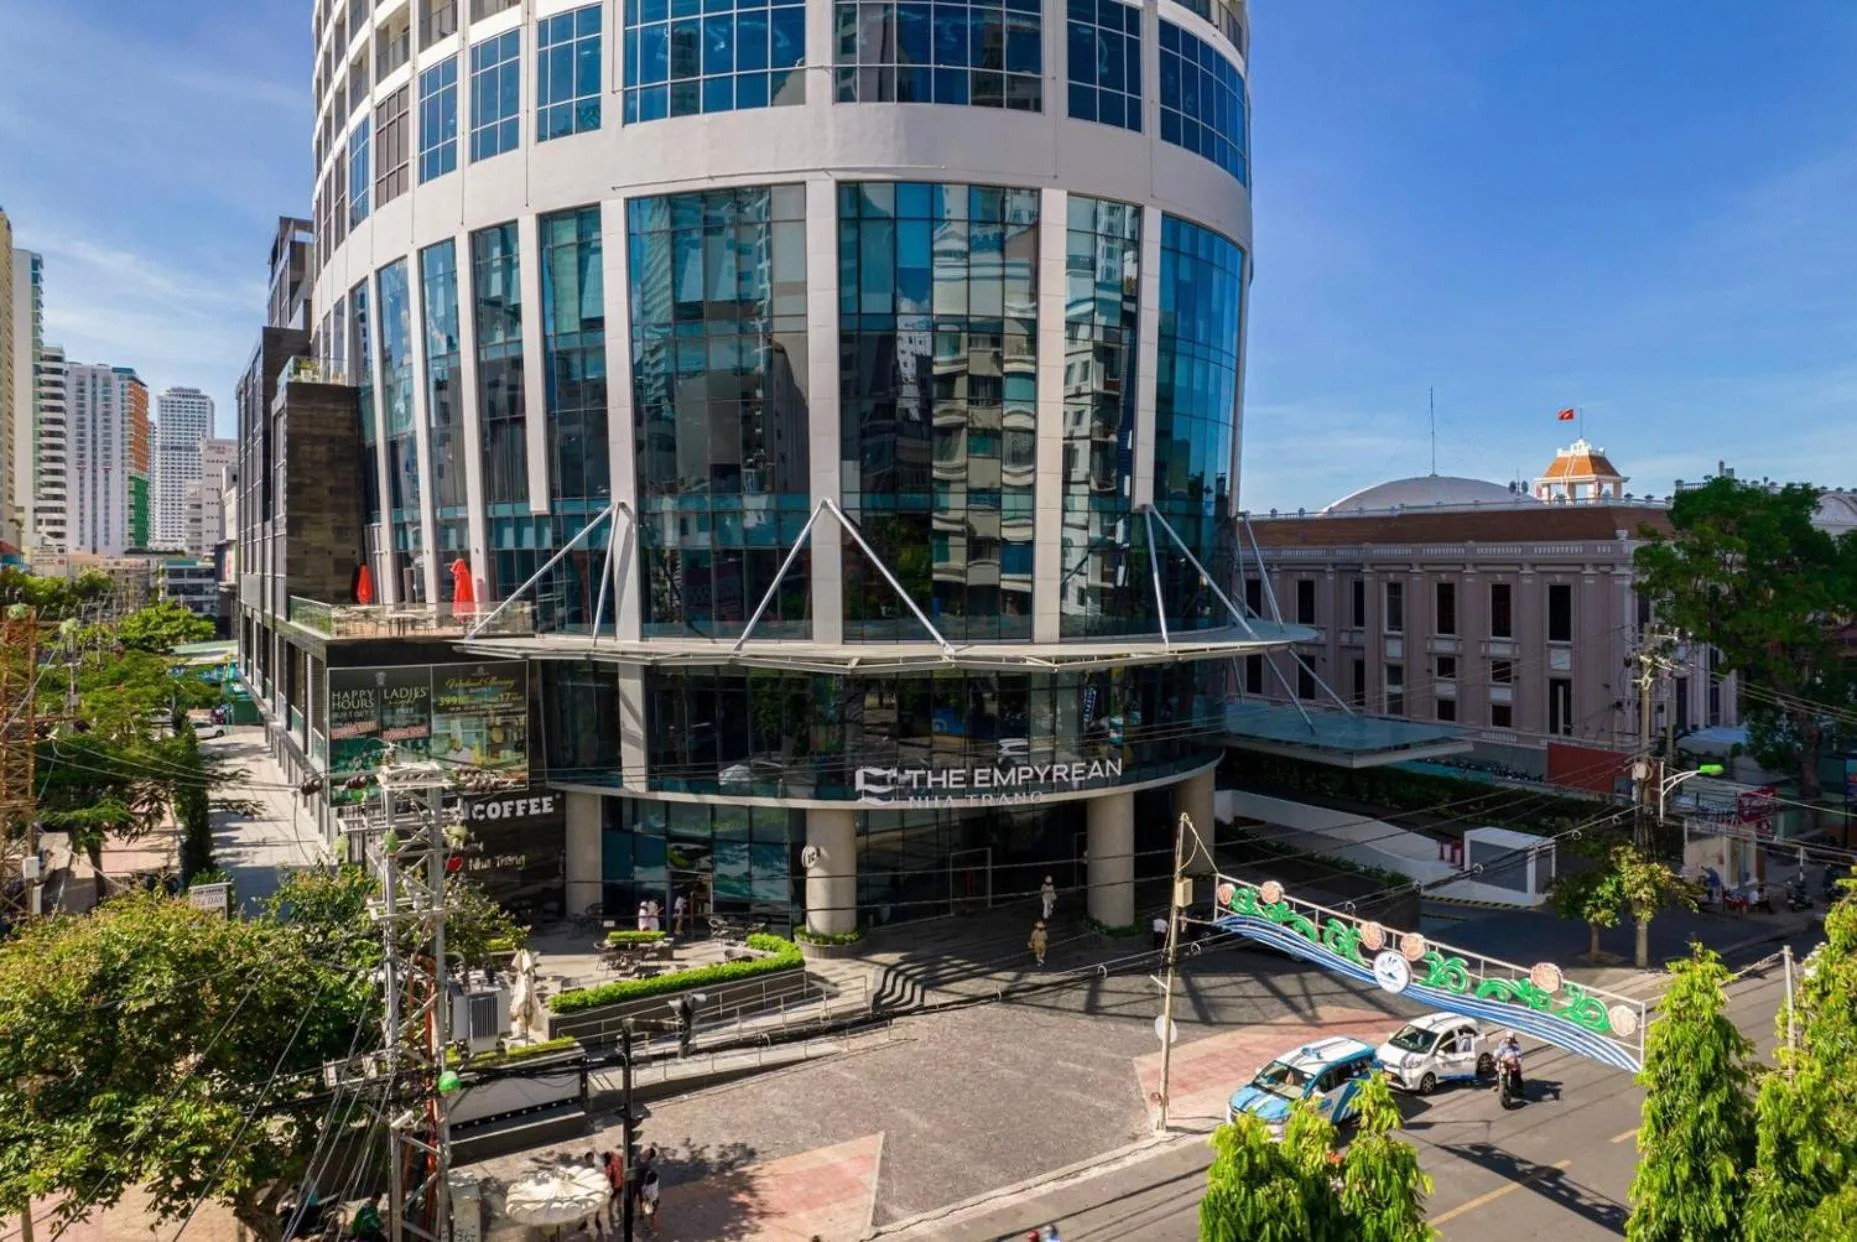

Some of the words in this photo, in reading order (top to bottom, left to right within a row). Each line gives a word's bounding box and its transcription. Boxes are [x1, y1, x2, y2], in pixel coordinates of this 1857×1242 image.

[332, 688, 374, 700] HAPPY
[332, 698, 374, 710] HOURS
[904, 769, 967, 789] THE
[973, 757, 1123, 788] EMPYREAN
[908, 794, 954, 808] NHA
[964, 790, 1043, 807] TRANG
[471, 796, 554, 821] COFFEE
[468, 858, 492, 871] Nha
[495, 854, 527, 870] Trang
